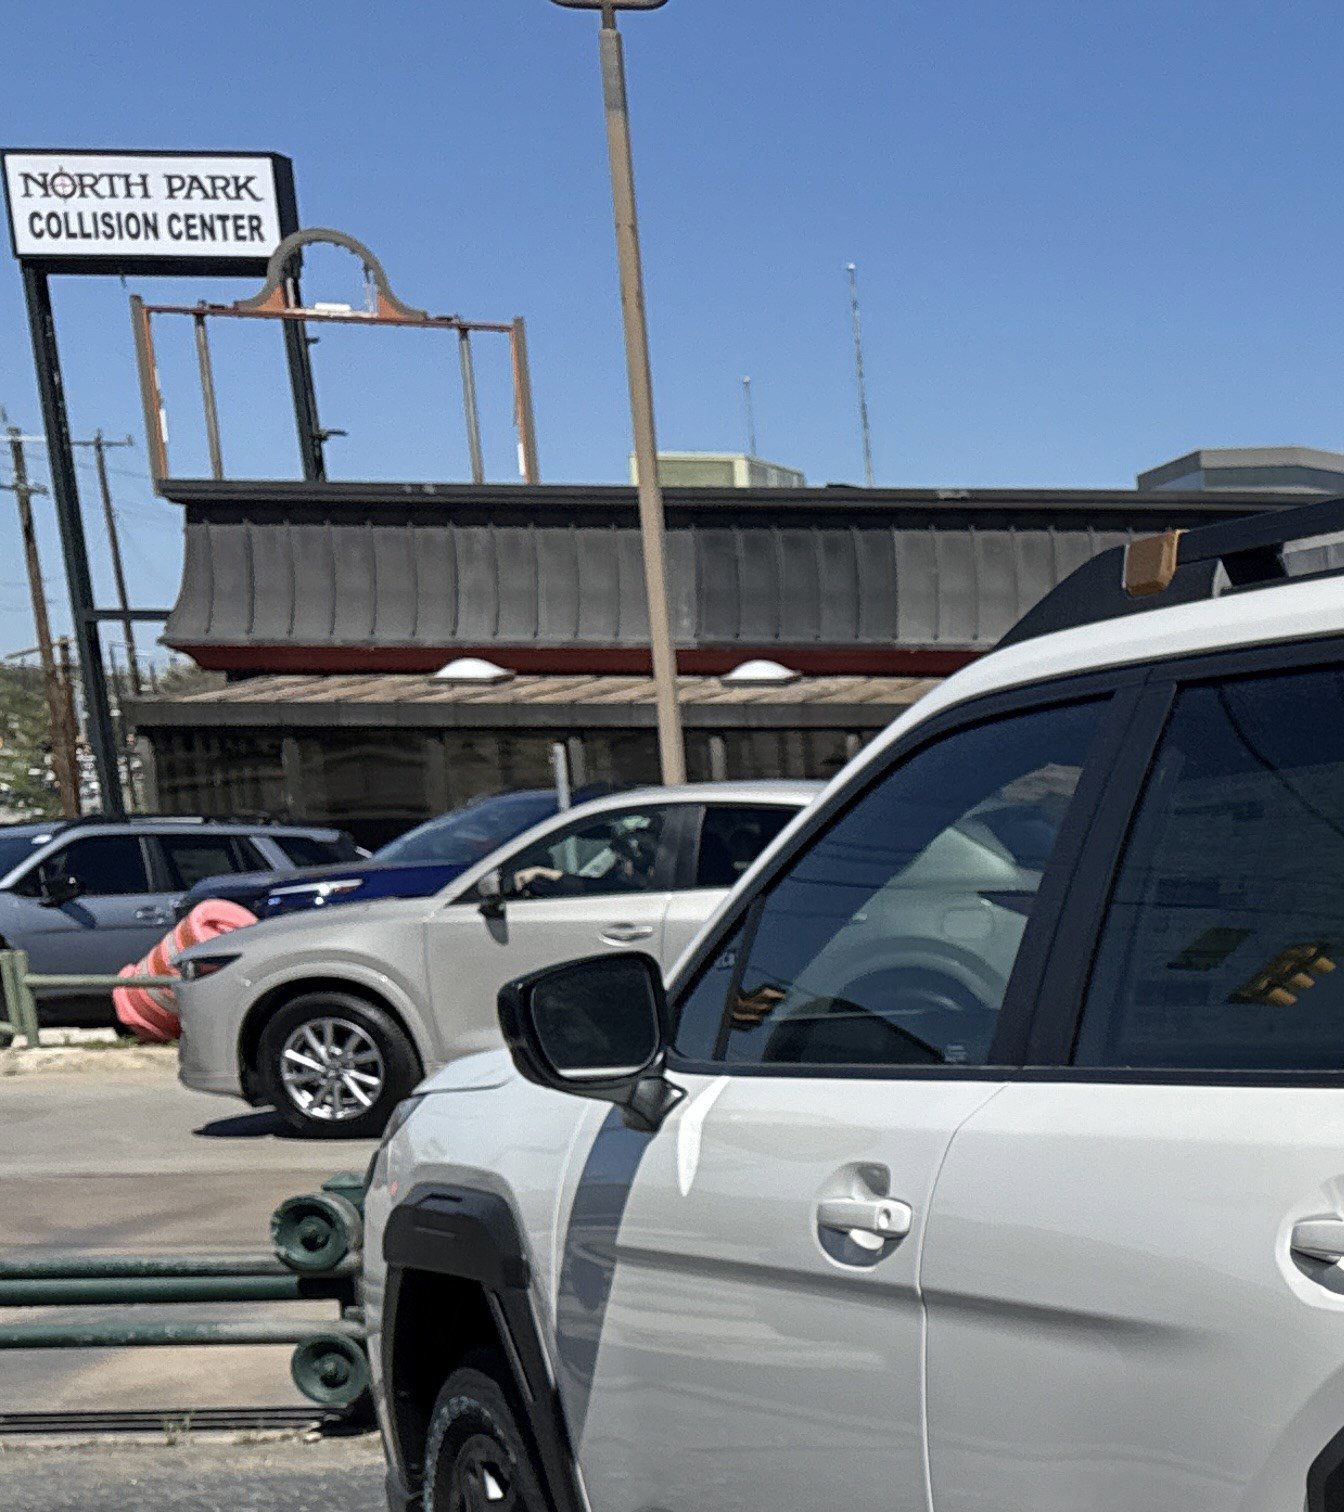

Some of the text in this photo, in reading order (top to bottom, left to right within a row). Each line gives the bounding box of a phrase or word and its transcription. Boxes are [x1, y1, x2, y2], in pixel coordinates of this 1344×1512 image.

[19, 171, 264, 202] NORTH PARK
[28, 211, 265, 243] COLLISION CENTER
